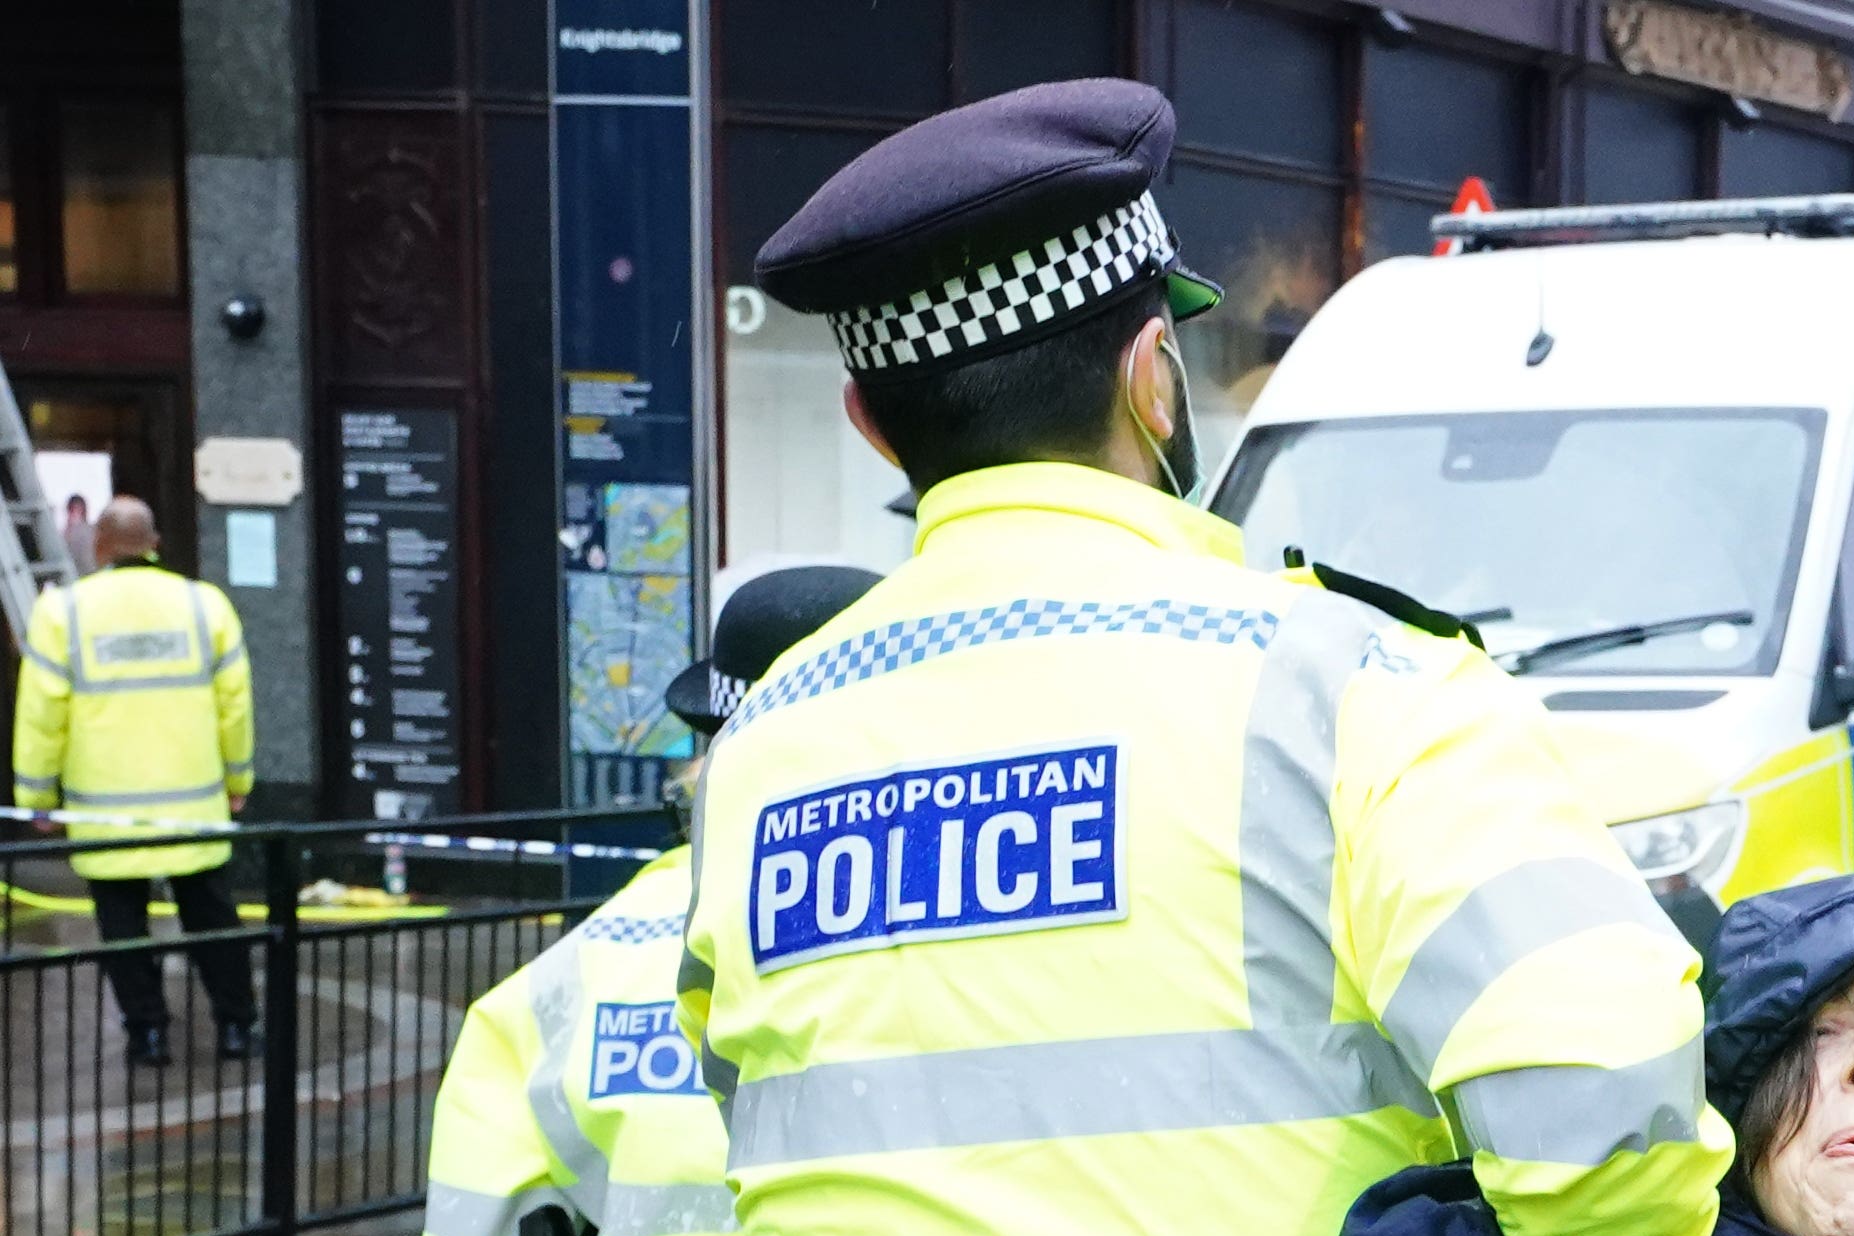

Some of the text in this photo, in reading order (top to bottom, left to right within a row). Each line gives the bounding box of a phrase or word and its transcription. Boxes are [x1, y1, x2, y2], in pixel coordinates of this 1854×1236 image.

[560, 27, 682, 54] Knightsbridge
[763, 755, 1106, 845] METROPOLITAN
[757, 801, 1104, 951] POLICE
